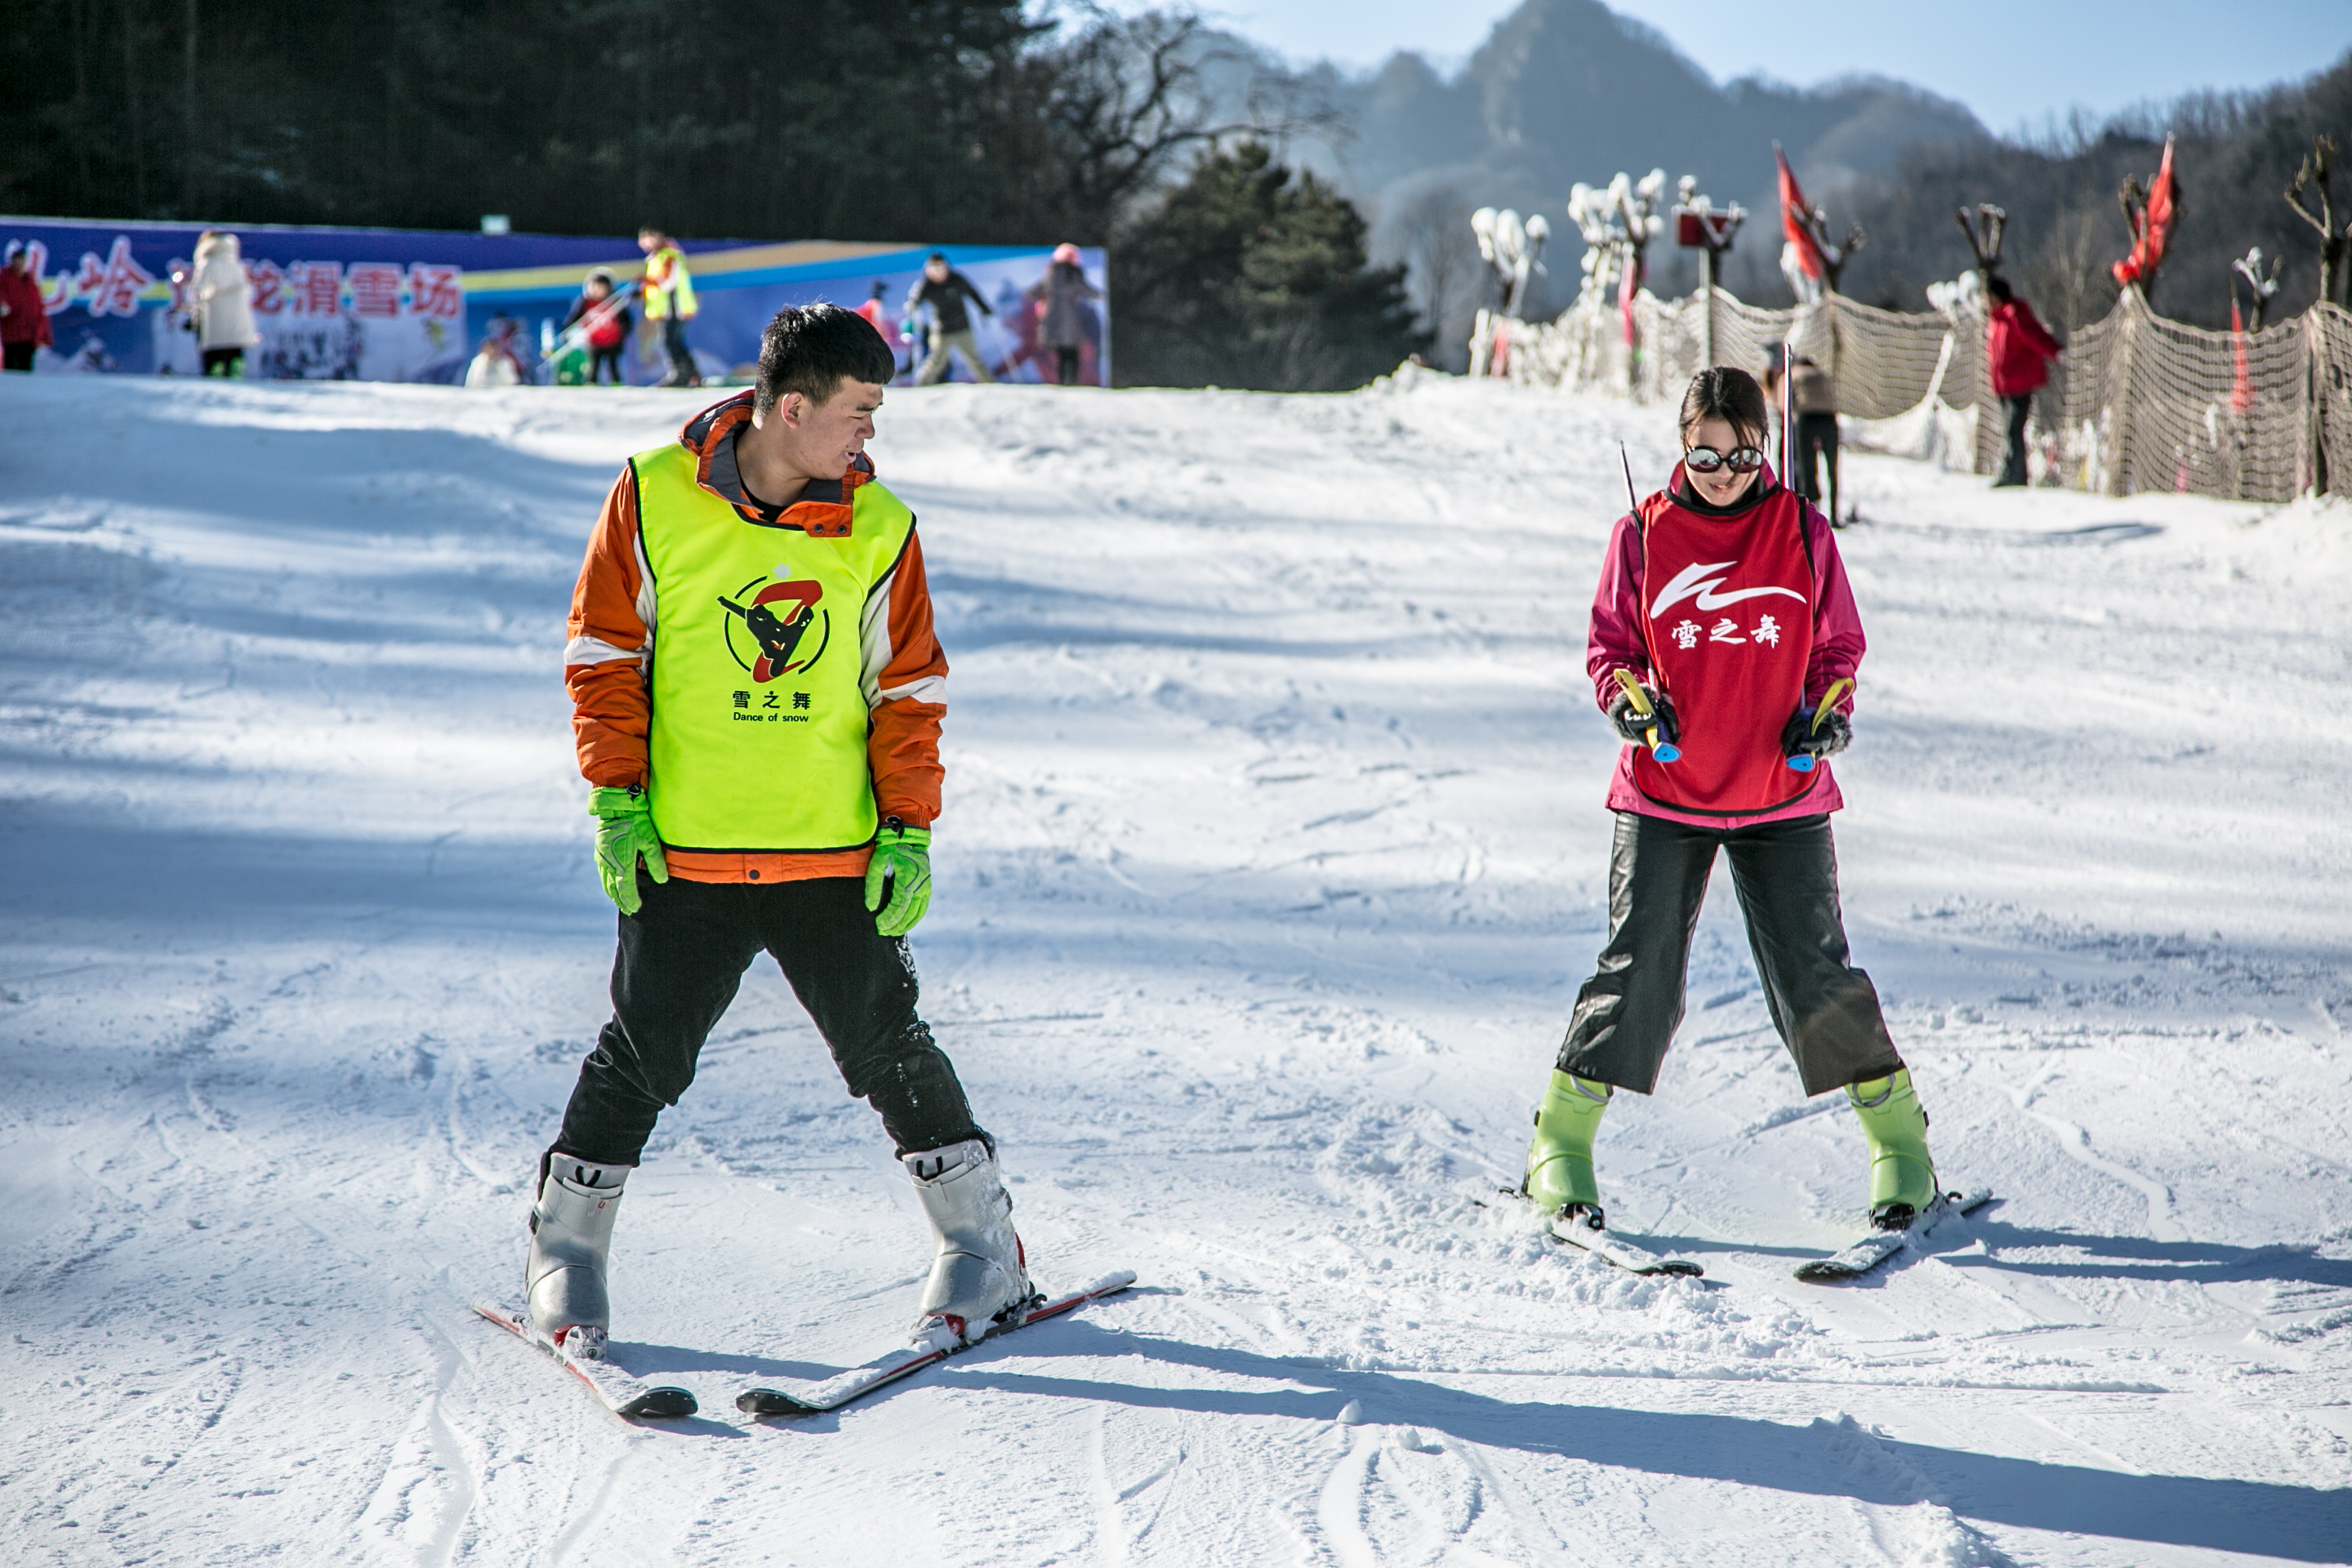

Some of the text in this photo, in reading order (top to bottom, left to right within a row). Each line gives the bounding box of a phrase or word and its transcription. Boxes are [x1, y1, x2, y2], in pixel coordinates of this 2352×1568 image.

[1671, 613, 1781, 649] 雪之舞
[732, 690, 811, 710] 雪之舞
[733, 711, 809, 723] Dance of snow
